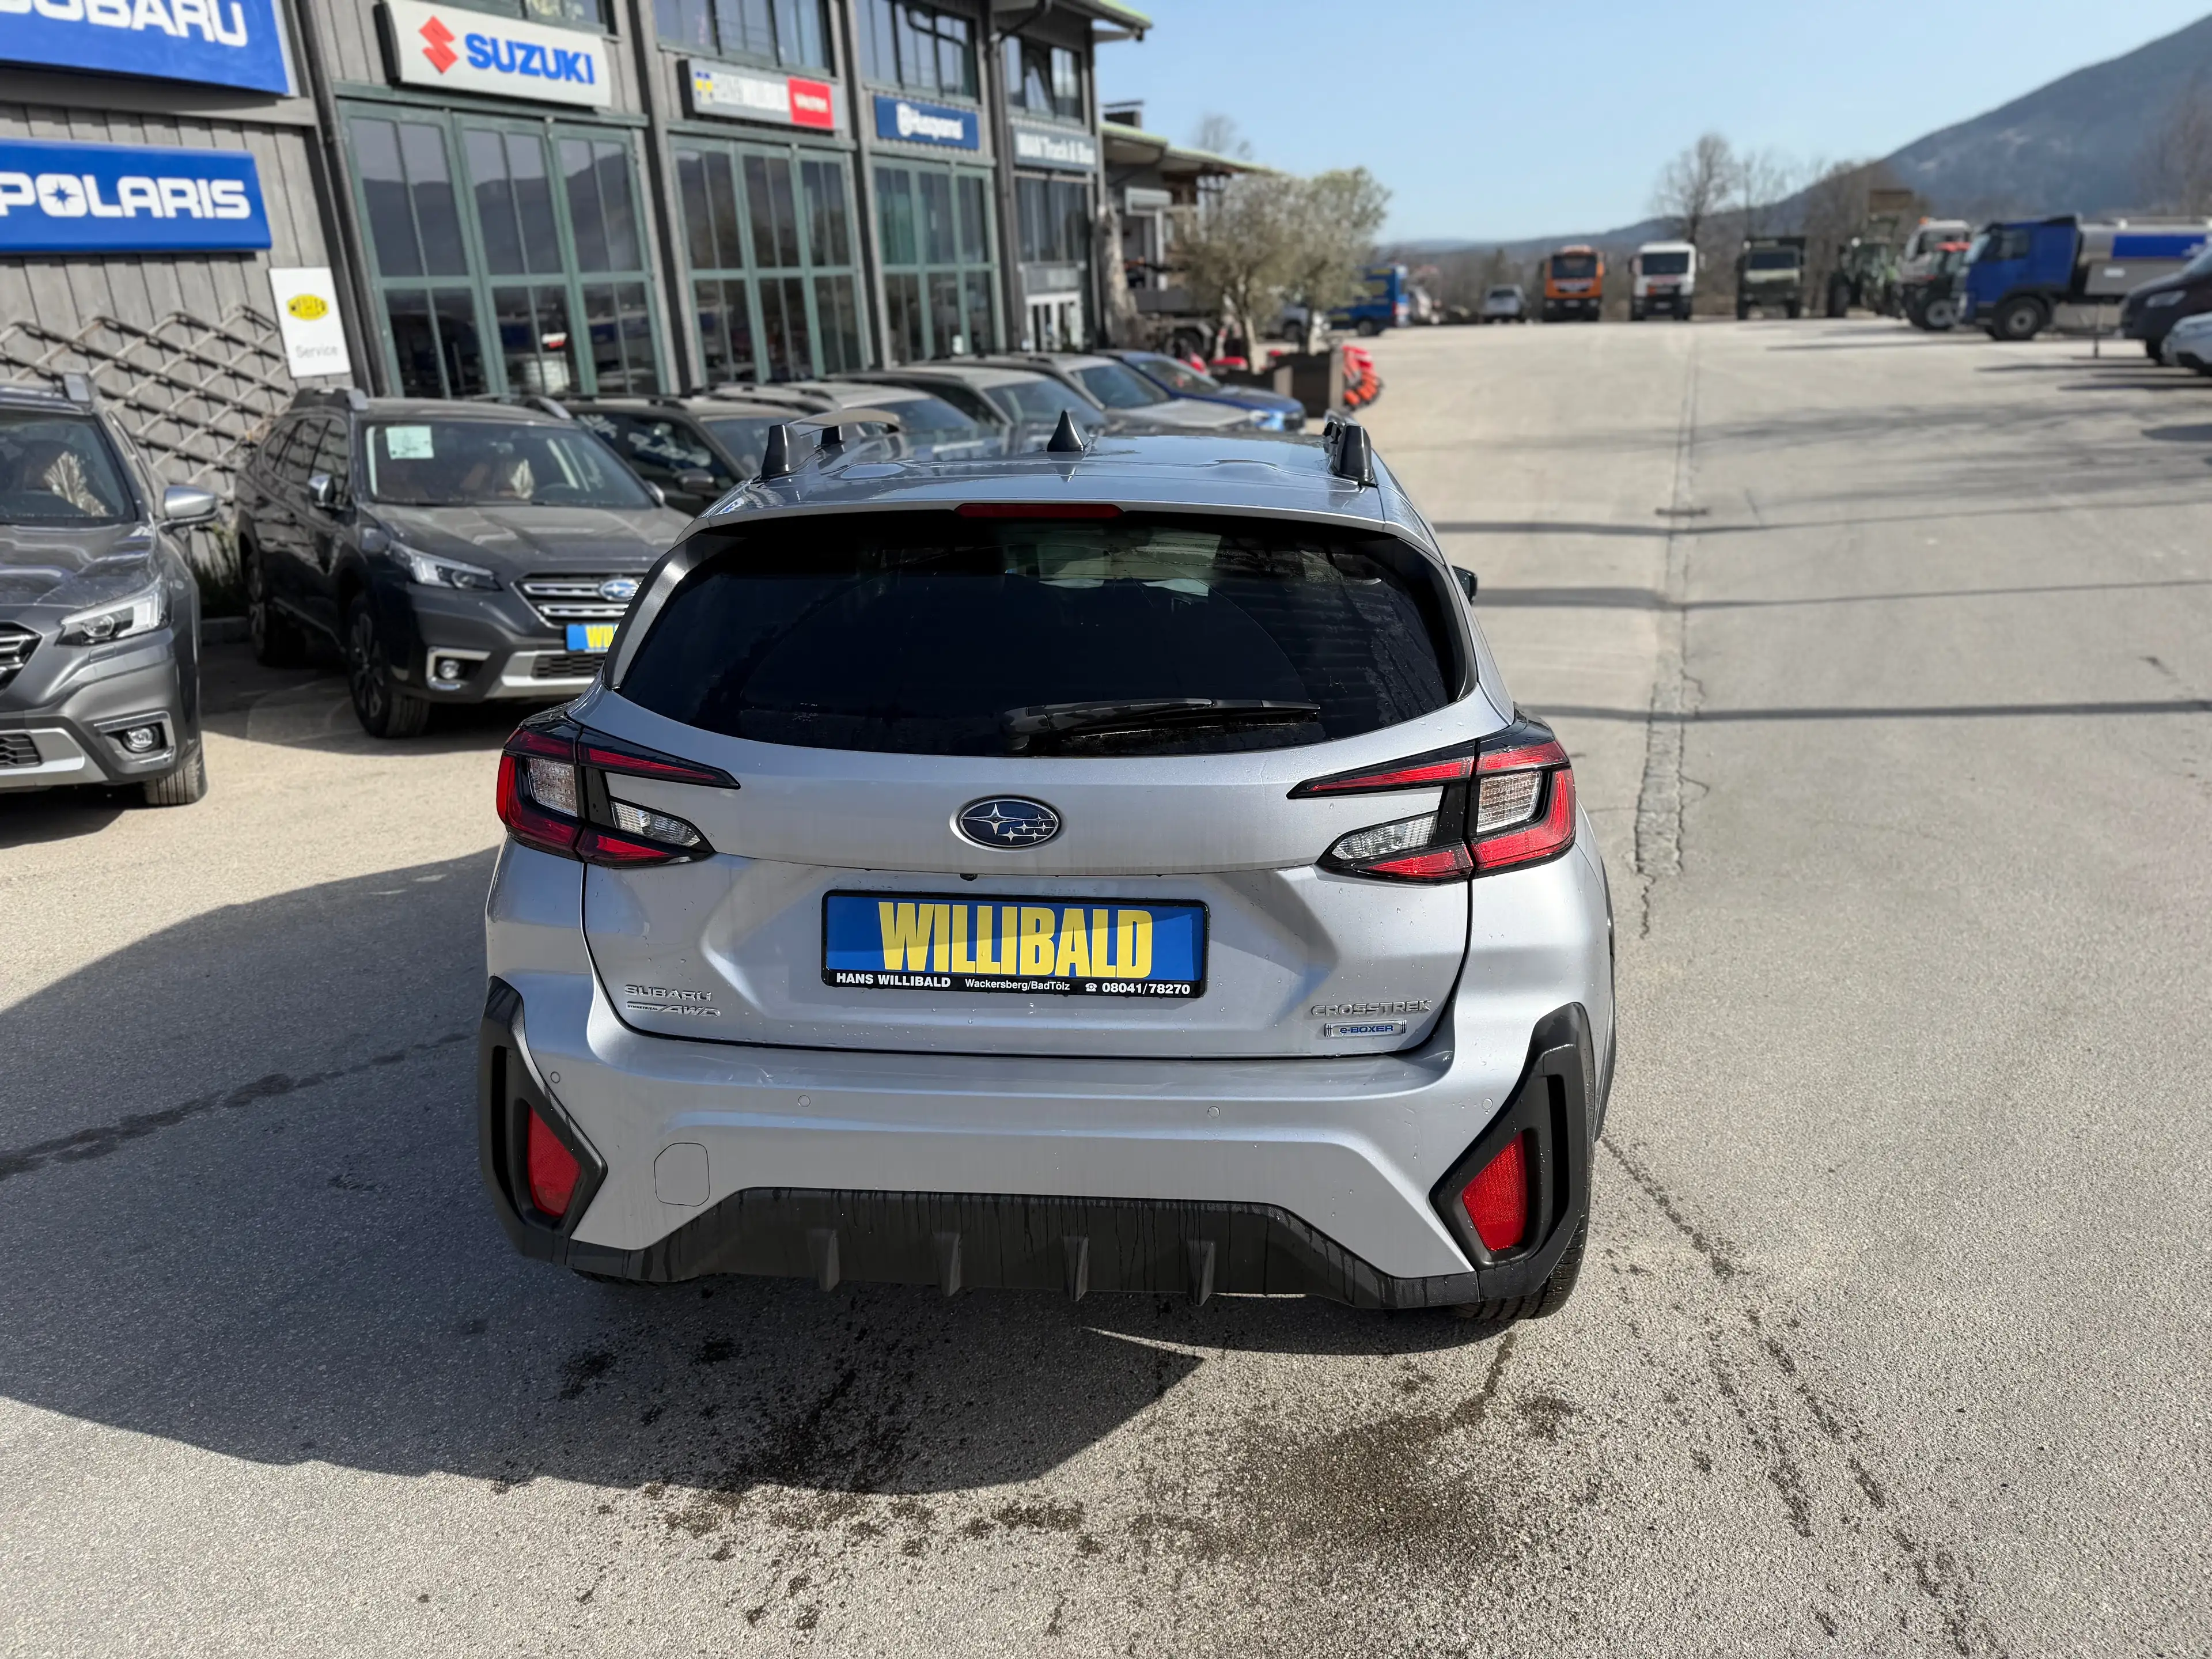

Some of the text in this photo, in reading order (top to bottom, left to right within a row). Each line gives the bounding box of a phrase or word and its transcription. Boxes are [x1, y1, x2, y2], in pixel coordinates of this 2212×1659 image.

[0, 0, 247, 47] BARU
[465, 33, 595, 85] SUZUKI
[0, 172, 251, 219] POLARIS
[878, 902, 1153, 979] WILLIBALD
[624, 984, 713, 1002] SUBARU
[836, 972, 1191, 995] HANS WILLIBALD Wackersberg/BadTölz 08041/78270
[661, 1005, 721, 1017] AWD
[1311, 999, 1432, 1017] CROSSTREK
[1339, 1025, 1393, 1033] e-BOXER
